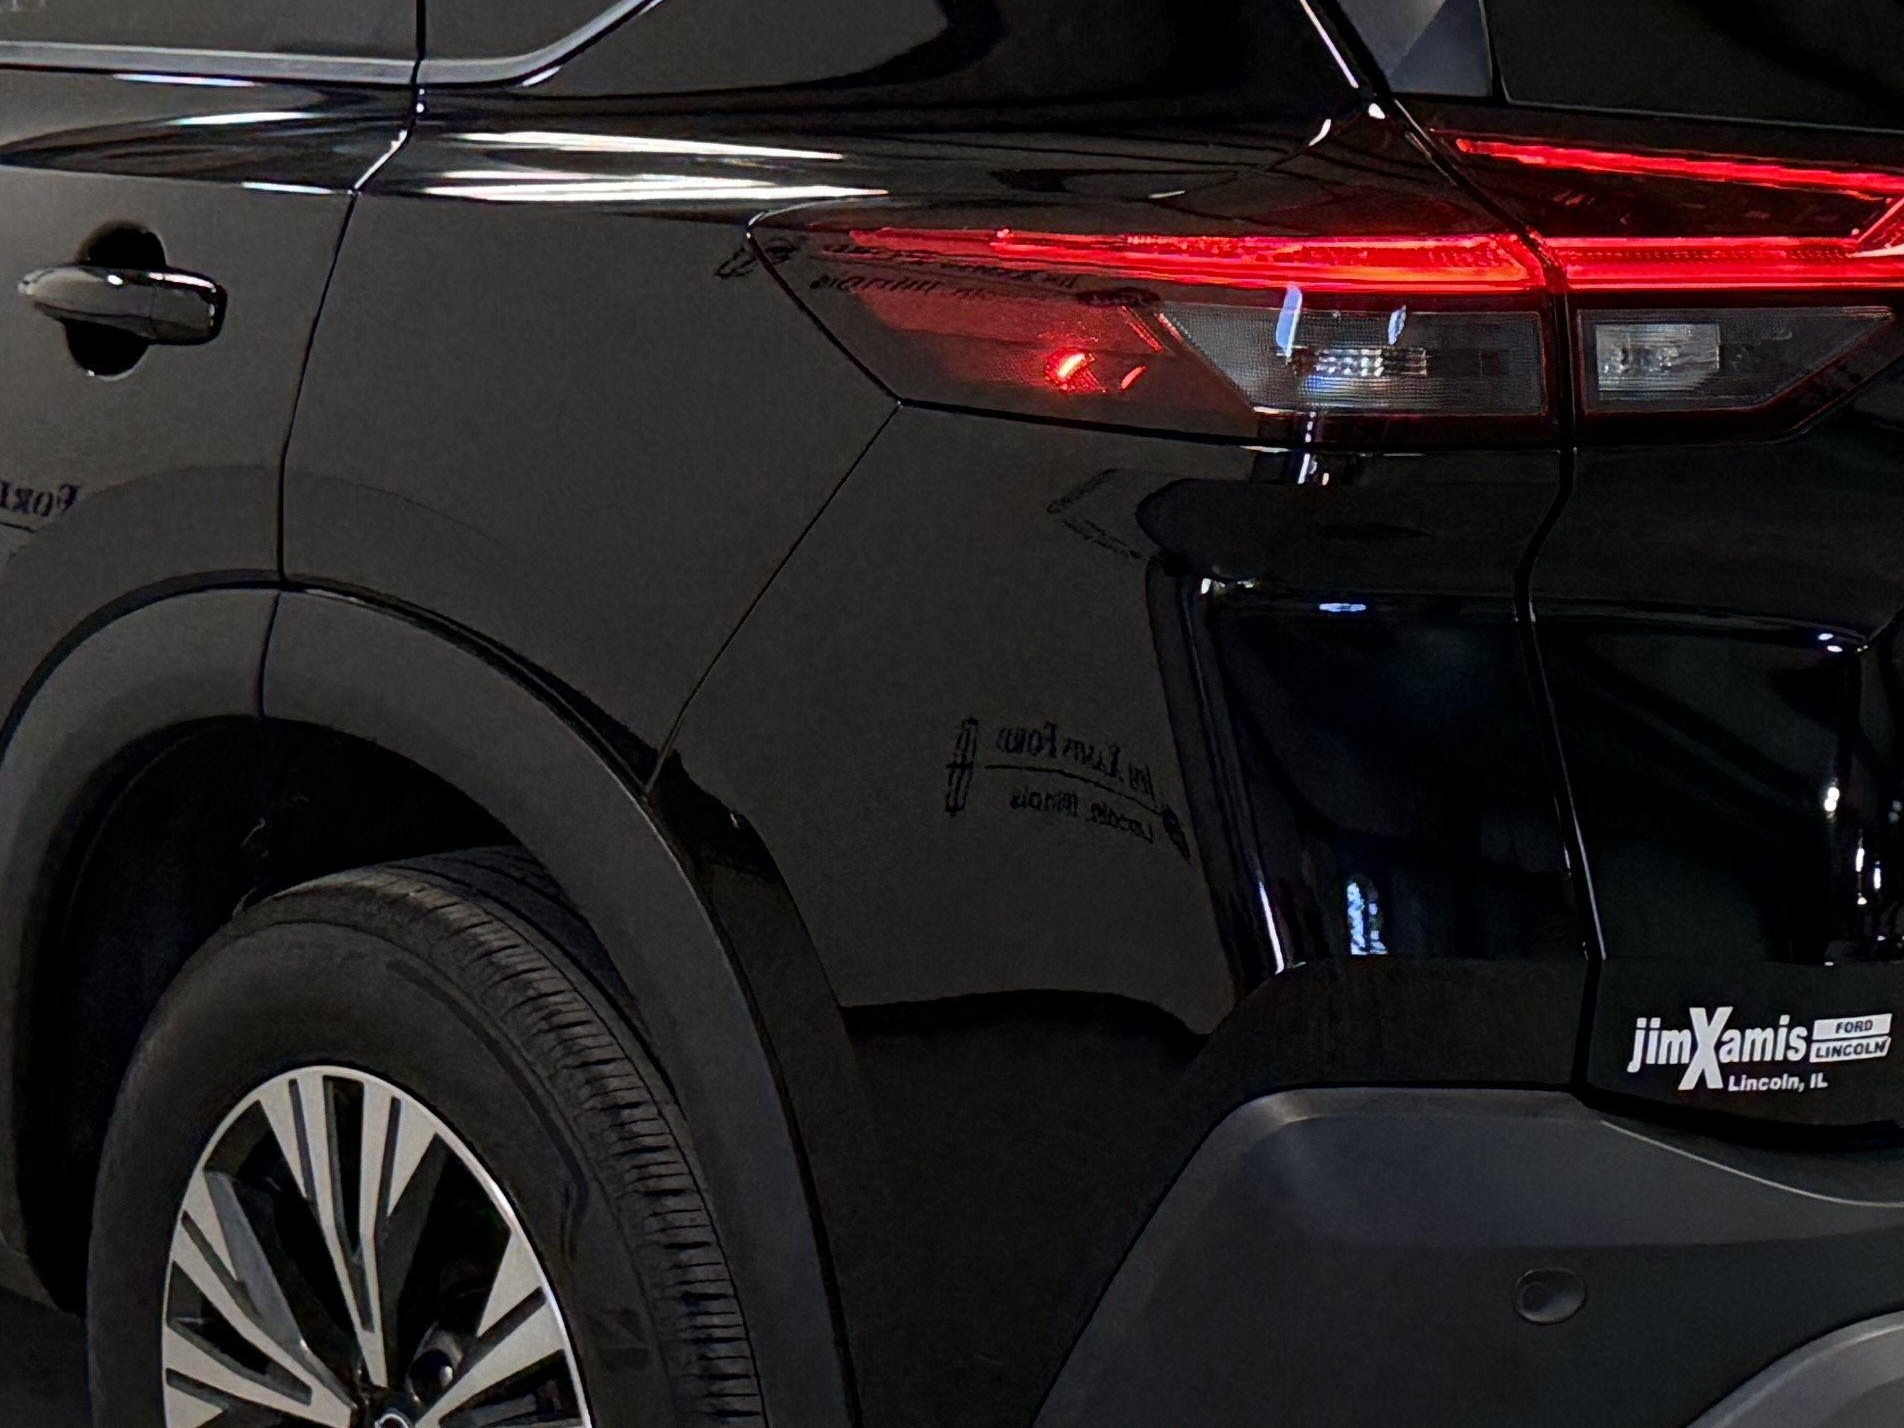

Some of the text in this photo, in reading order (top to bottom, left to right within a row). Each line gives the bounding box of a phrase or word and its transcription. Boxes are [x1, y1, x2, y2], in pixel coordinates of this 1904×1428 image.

[1834, 1019, 1874, 1034] FORD
[1814, 1038, 1889, 1059] LINCOLN
[1727, 1072, 1829, 1093] Lincoln, IL
